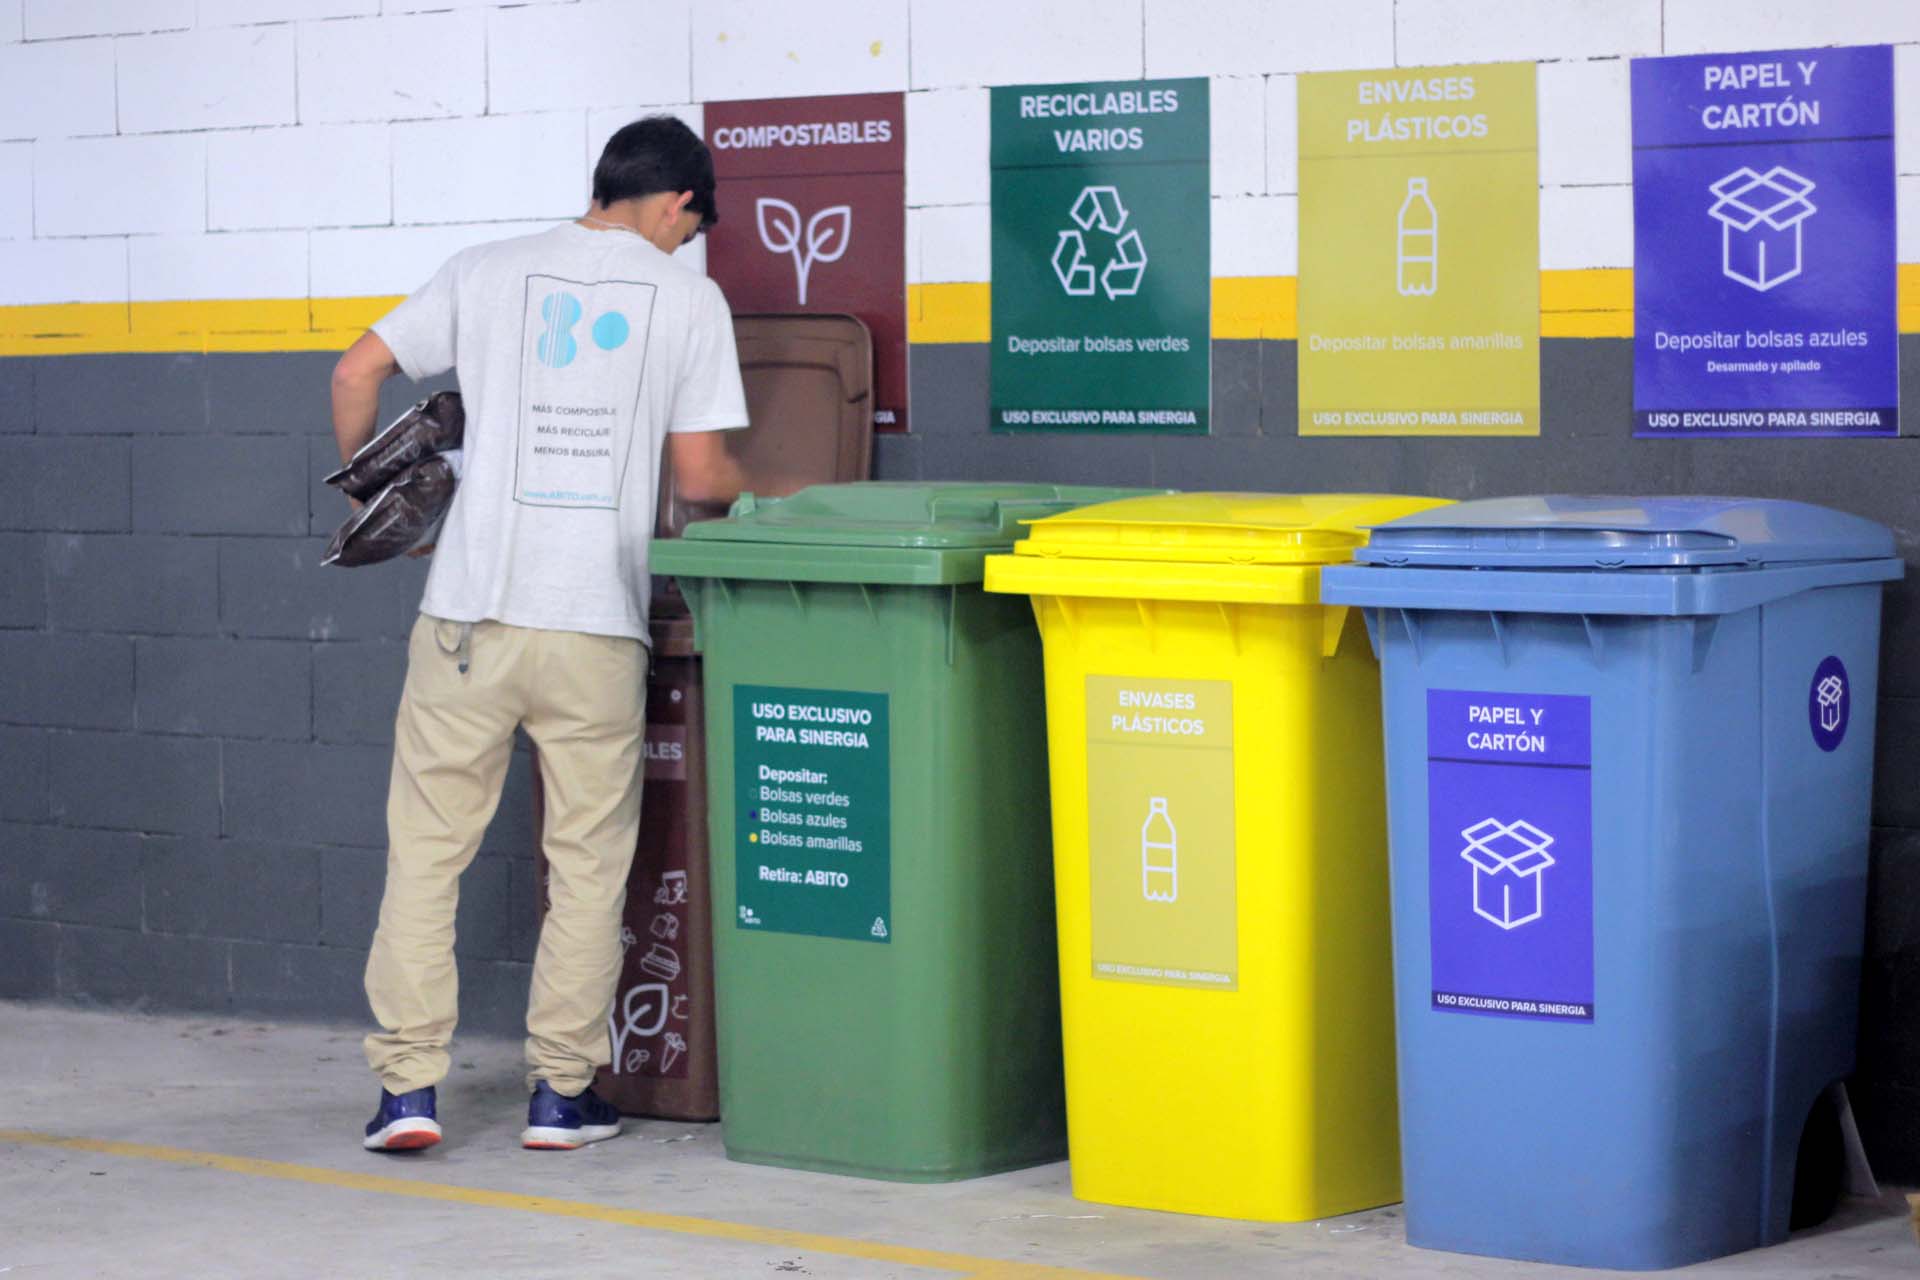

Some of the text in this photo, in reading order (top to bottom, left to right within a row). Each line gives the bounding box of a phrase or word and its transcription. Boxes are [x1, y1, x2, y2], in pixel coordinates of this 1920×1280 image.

[1704, 61, 1818, 90] PAPEL Y
[1359, 77, 1475, 104] ENVASES
[1020, 89, 1179, 119] RECICLABLES
[1703, 97, 1819, 130] CARTÓN
[713, 119, 892, 150] COMPOSTABLES
[1346, 112, 1488, 143] PLÁSTICOS
[1054, 128, 1144, 153] VARIOS
[1007, 334, 1190, 356] Depositar bolsas verdes
[1309, 332, 1524, 353] Depositar bolsas amarillas
[1654, 328, 1869, 352] Depositar bolsas azules
[1706, 359, 1822, 373] Desarmado y apilado
[1002, 411, 1197, 425] USO EXCLUSIVO PARA SINERGIA
[1312, 411, 1524, 426] USO EXCLUSIVO PARA SINERGIA
[1648, 412, 1880, 428] USO EXCLUSIVO PARA SINERGIA
[534, 446, 570, 456] MENOS
[1119, 690, 1195, 710] ENVASES
[752, 703, 872, 725] USO EXCLUSIVO
[1111, 713, 1205, 736] PLÁSTICOS
[1469, 706, 1544, 726] PAPEL Y
[756, 726, 869, 748] PARA SINERGIA
[1467, 730, 1545, 753] CARTÓN
[759, 765, 828, 785] Depositar:
[760, 786, 850, 807] Bolsas verdes
[760, 808, 848, 828] Bolsas azules
[760, 830, 863, 852] Bolsas amarillas
[759, 866, 849, 887] Retira: ABITO
[1437, 994, 1586, 1015] USO EXCLUSIVO PARA SINERGIA
